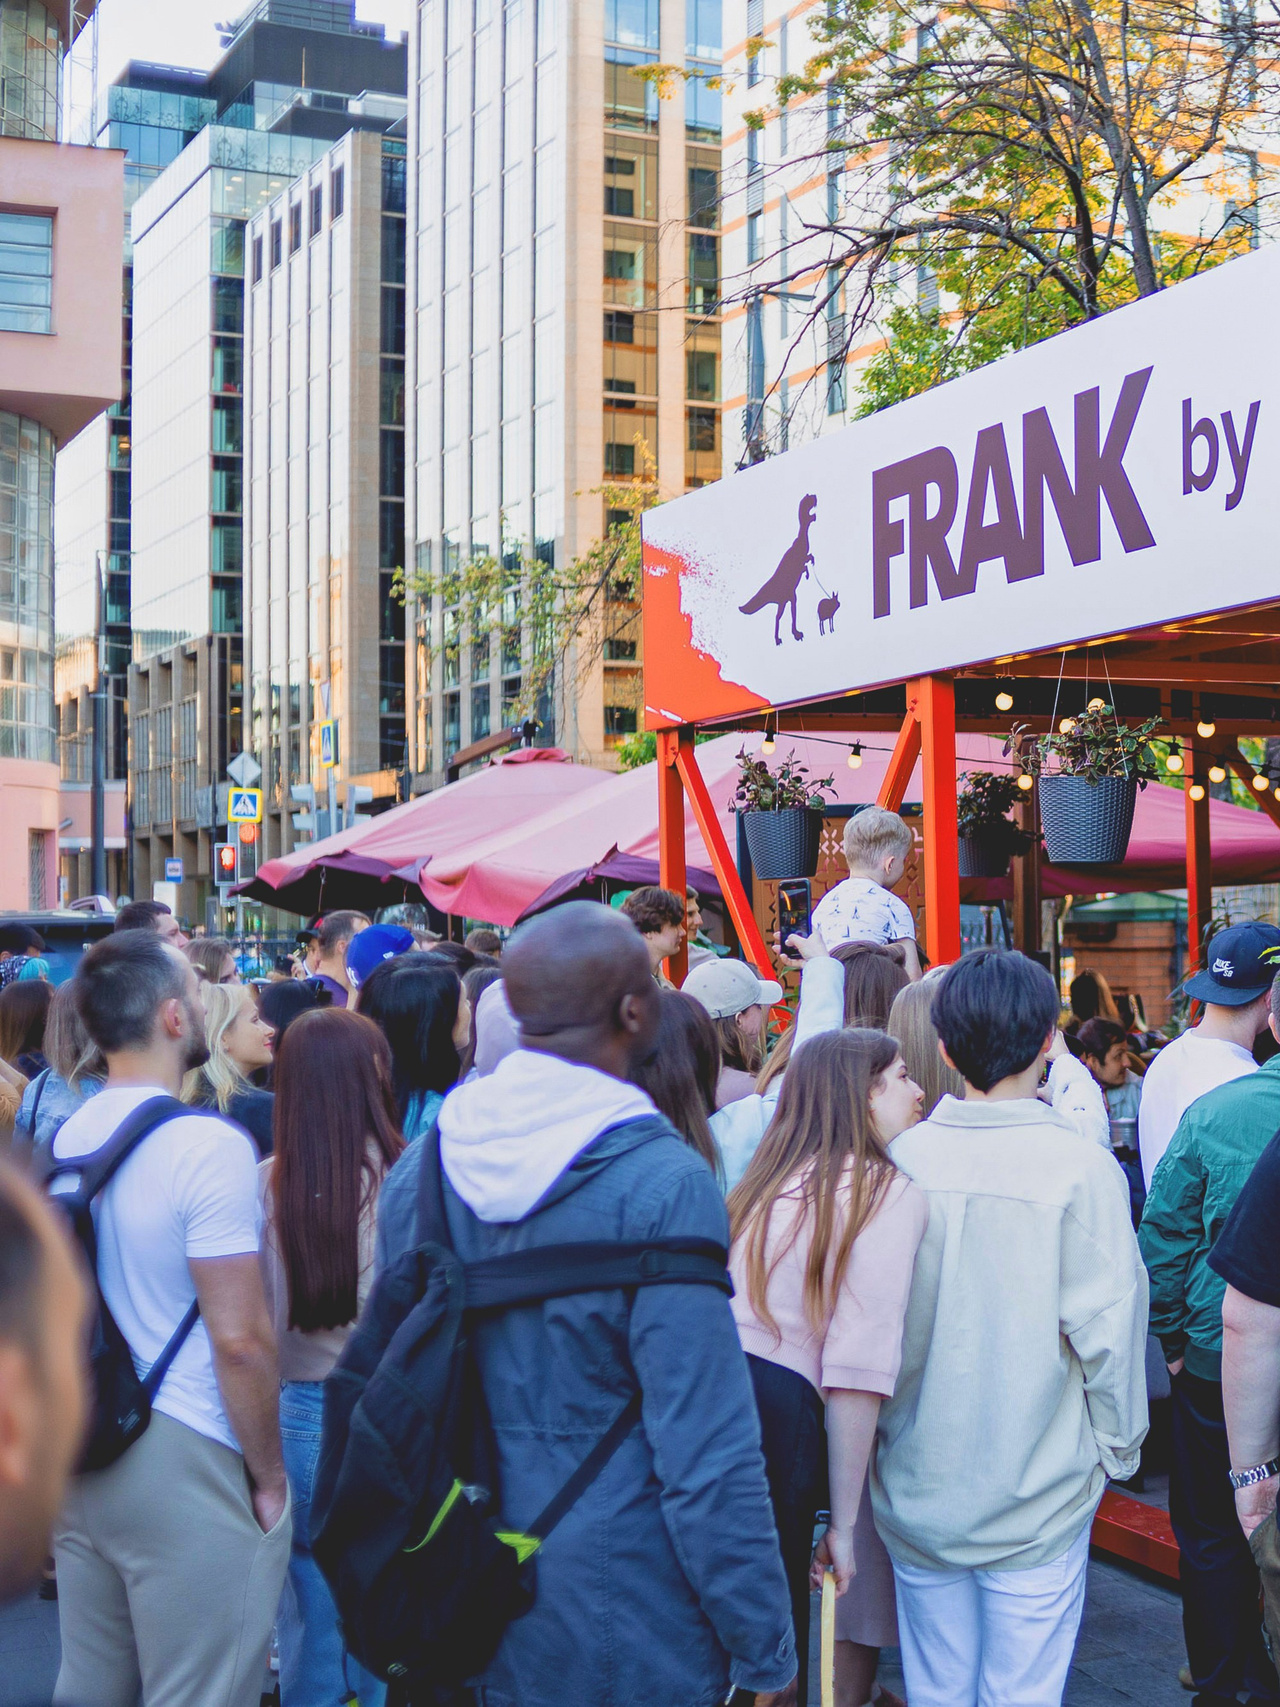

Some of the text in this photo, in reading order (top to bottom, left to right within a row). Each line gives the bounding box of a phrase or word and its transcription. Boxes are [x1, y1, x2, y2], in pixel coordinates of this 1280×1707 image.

[872, 365, 1157, 619] FRANK
[1182, 398, 1261, 511] by
[1223, 969, 1234, 978] SB
